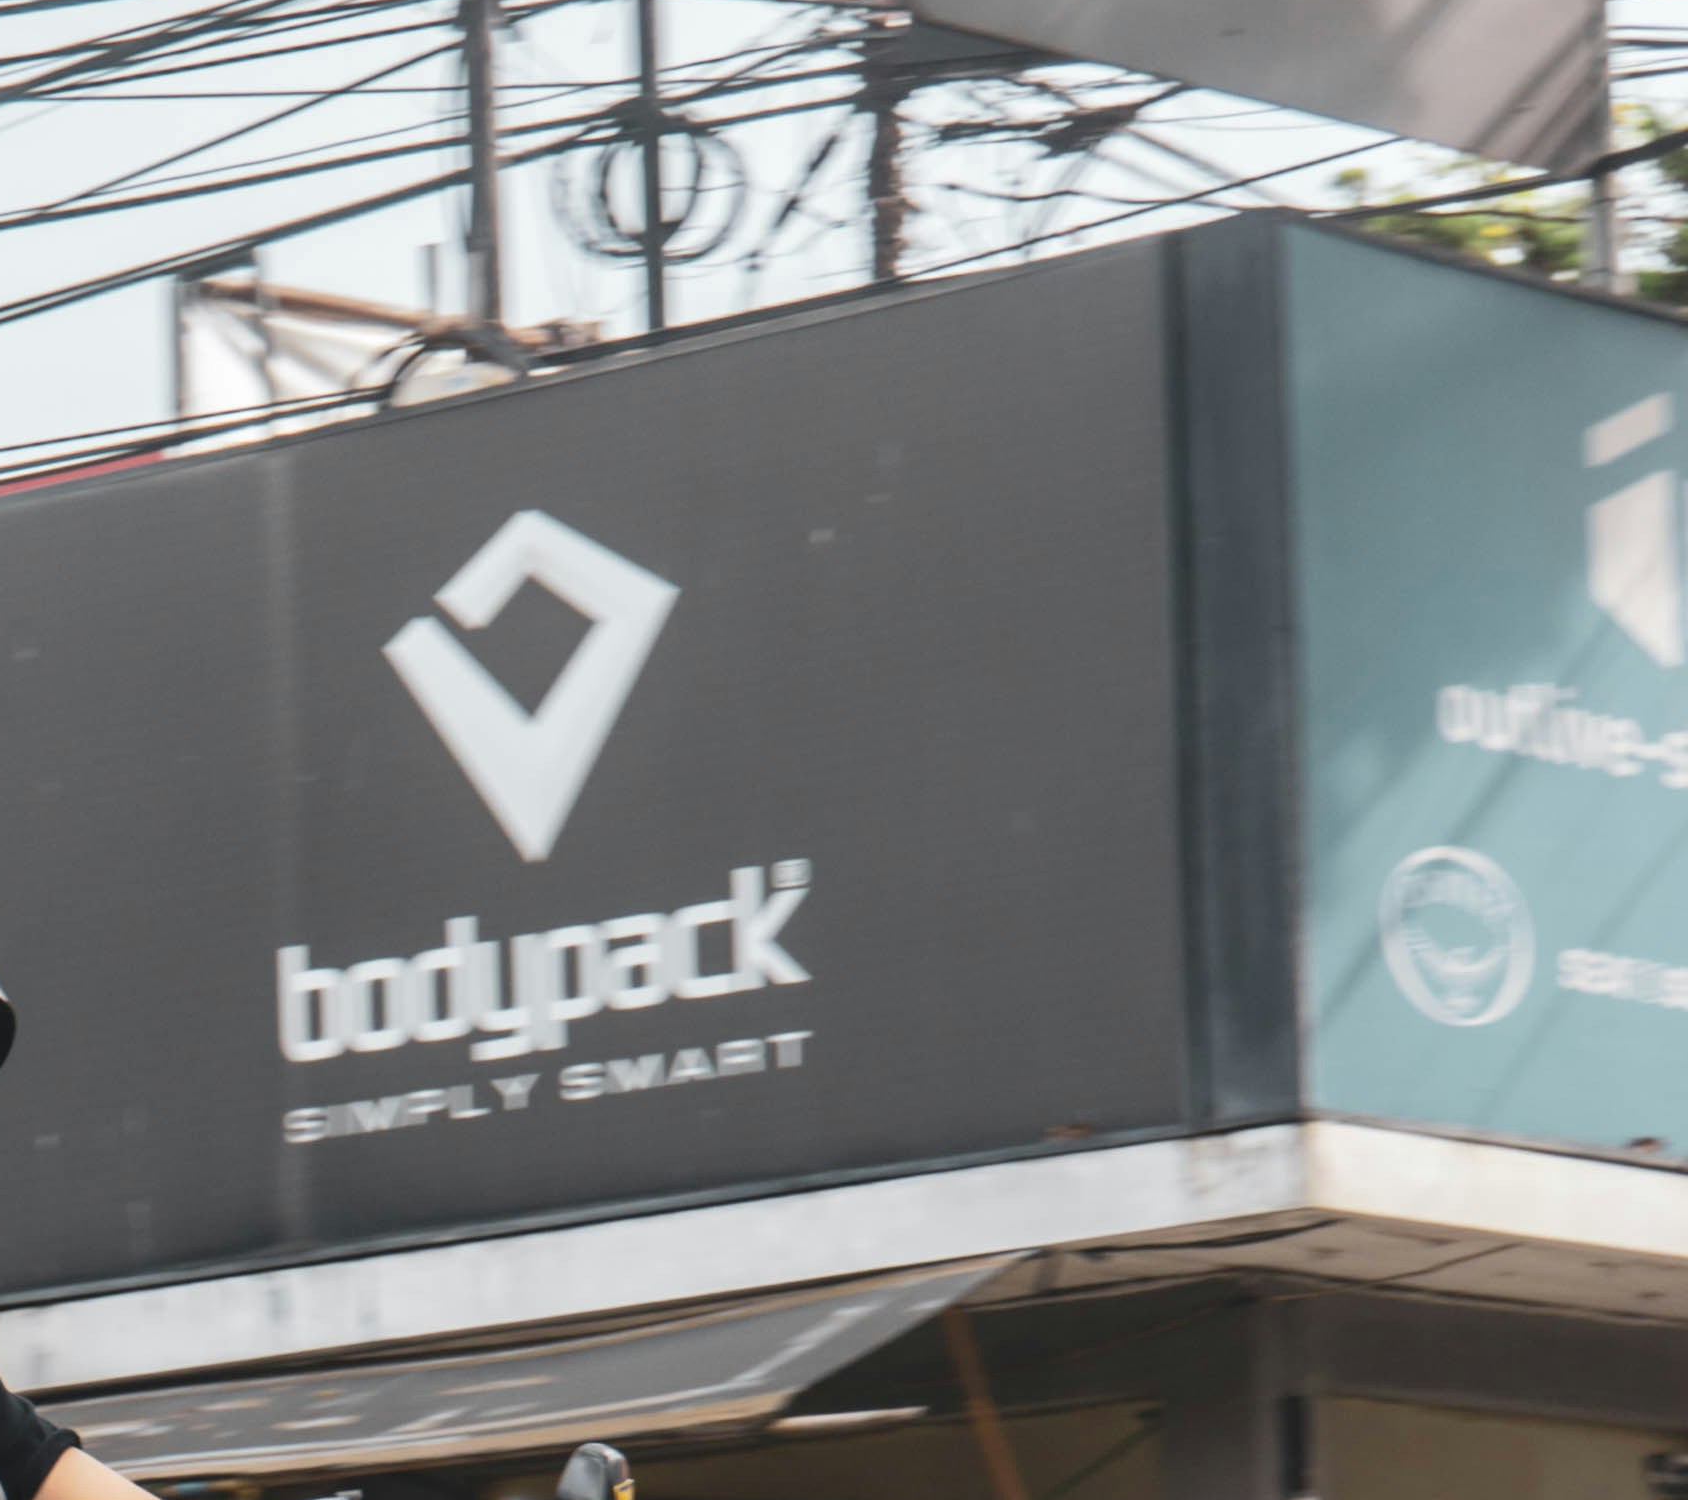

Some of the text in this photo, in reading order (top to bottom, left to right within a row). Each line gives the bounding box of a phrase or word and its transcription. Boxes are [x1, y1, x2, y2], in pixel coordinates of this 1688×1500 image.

[277, 859, 812, 1062] bodypack
[283, 1031, 813, 1143] SIMPLY SMART
